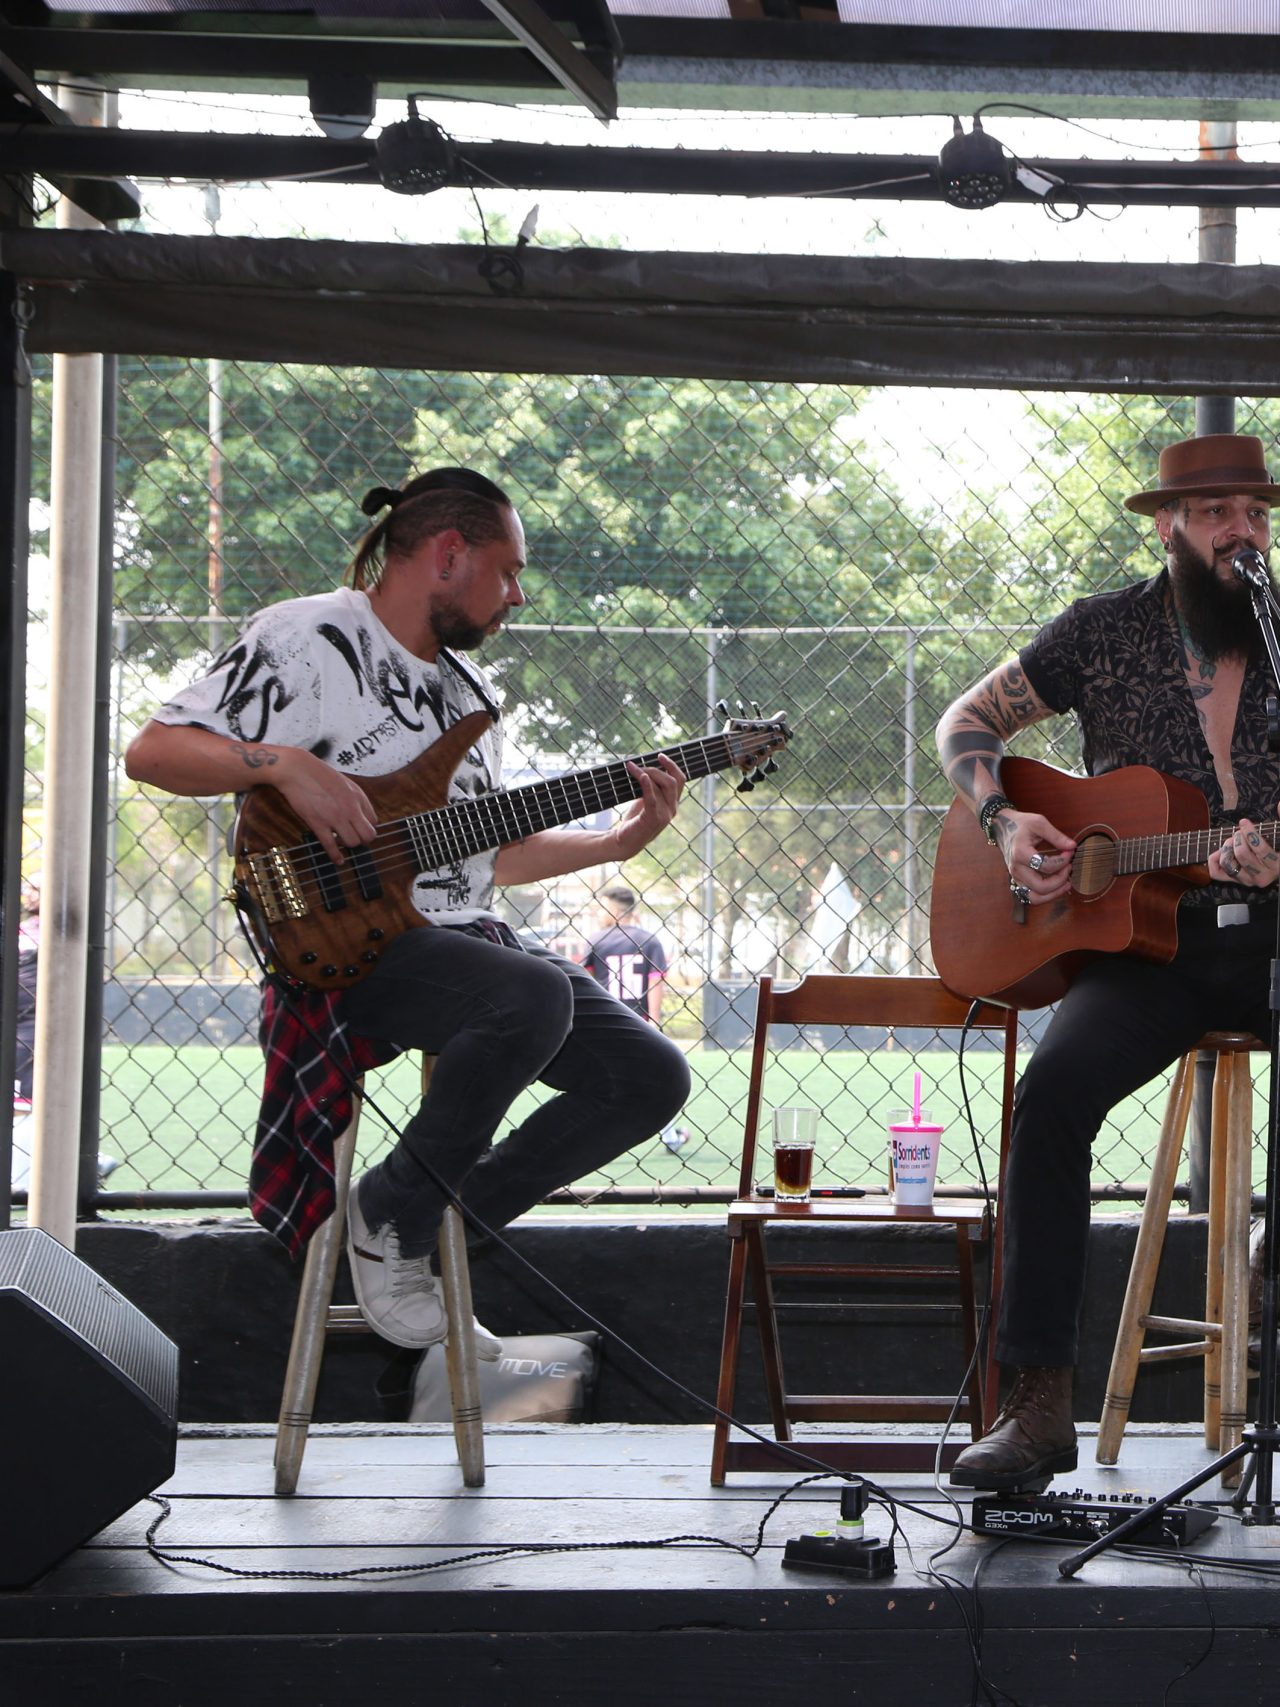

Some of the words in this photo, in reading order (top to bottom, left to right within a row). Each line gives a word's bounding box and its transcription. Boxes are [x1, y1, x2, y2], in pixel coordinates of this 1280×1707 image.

[898, 1142, 931, 1161] Sorridents
[498, 1358, 568, 1378] MOVE
[984, 1509, 1053, 1524] ZOOM
